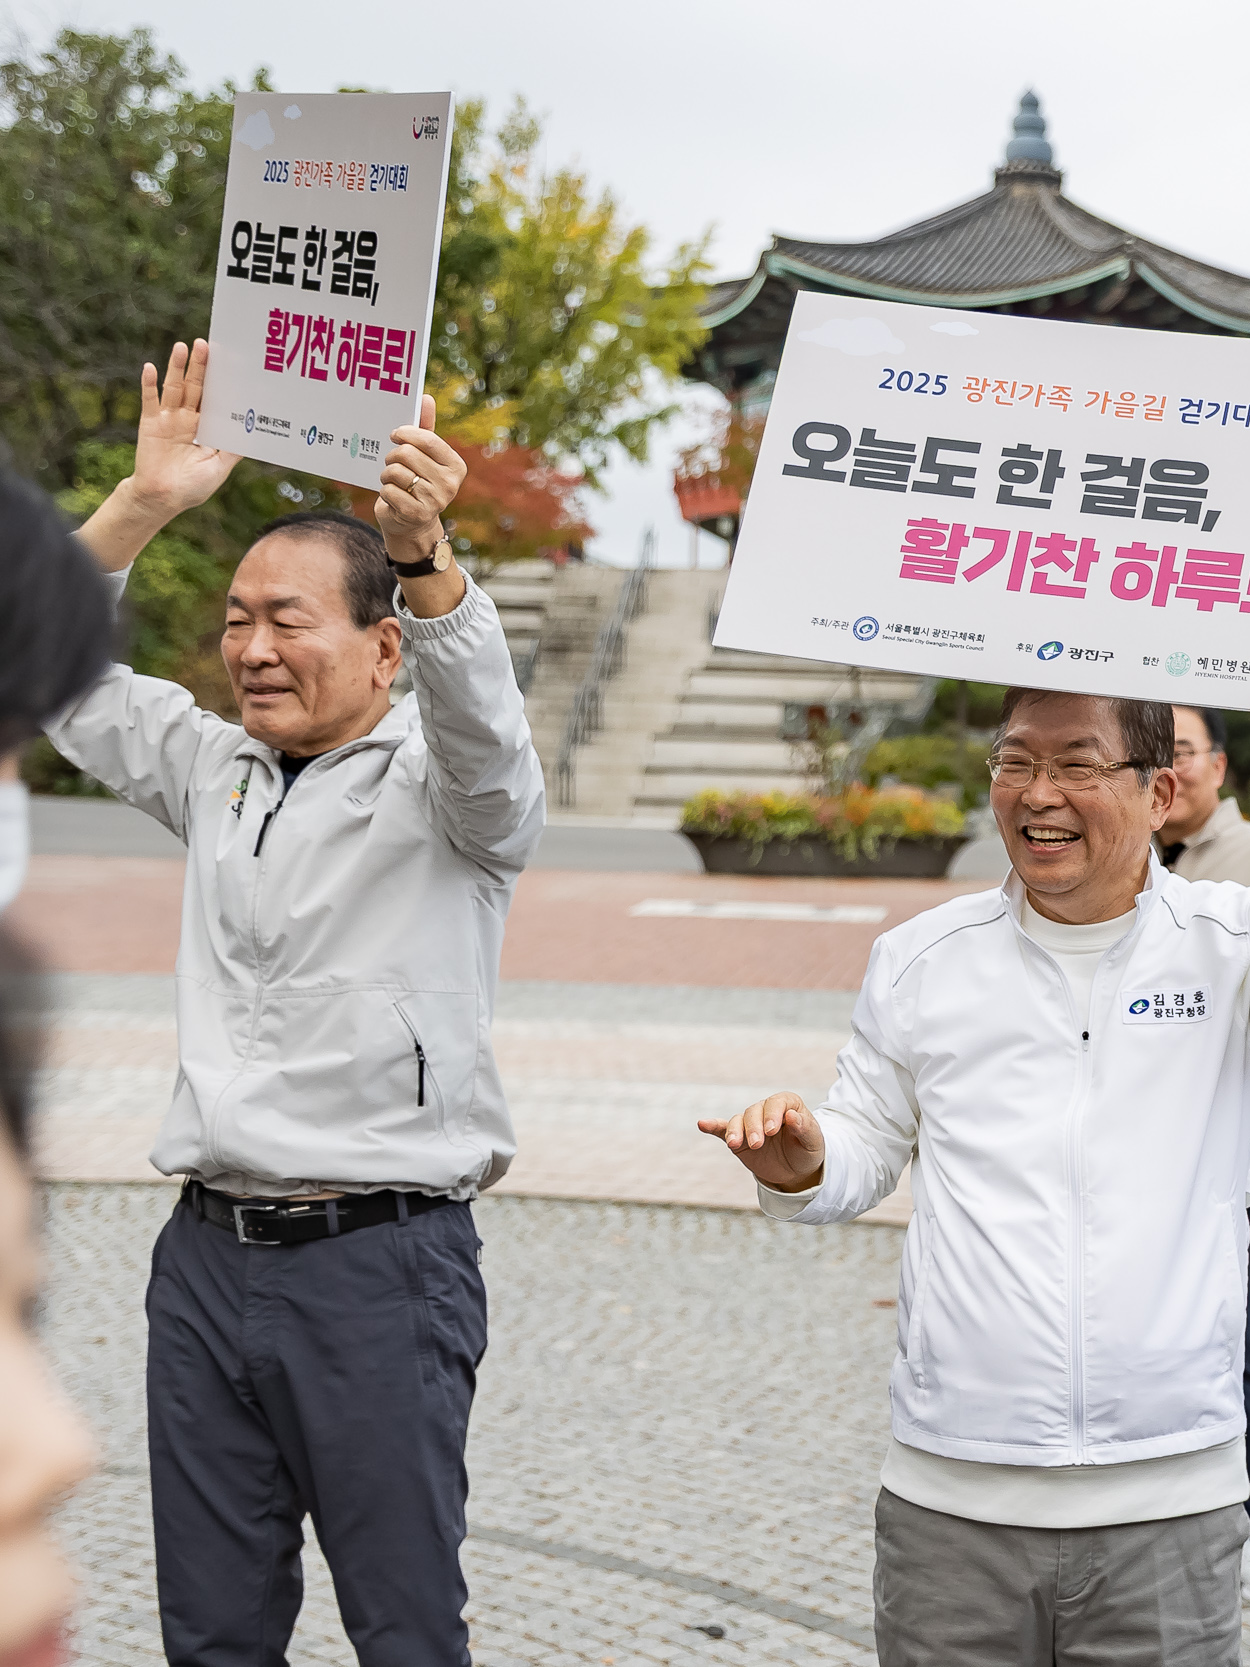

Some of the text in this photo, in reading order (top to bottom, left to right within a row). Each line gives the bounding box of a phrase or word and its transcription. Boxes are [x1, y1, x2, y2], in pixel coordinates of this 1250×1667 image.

[263, 159, 409, 192] 2025 광진가족 가을길 걷기대회
[226, 220, 379, 306] 오늘도 한 걸음,
[263, 307, 417, 396] 활기찬 하루로!
[878, 368, 948, 395] 2025
[963, 375, 1073, 412] 광진가족
[1084, 389, 1166, 422] 가을길
[782, 421, 1223, 532] 오늘도 한 걸음,
[900, 518, 1099, 599] 활기찬
[810, 617, 850, 631] 주최/주관
[885, 623, 930, 637] 서울특별시
[931, 628, 985, 643] 광진구체육회
[1016, 642, 1033, 653] 후원
[1067, 647, 1115, 663] 광진구
[1142, 656, 1160, 667] 협찬
[1194, 671, 1248, 682] HYEMIN HOSPITAL
[1153, 1005, 1206, 1019] 광진구청장
